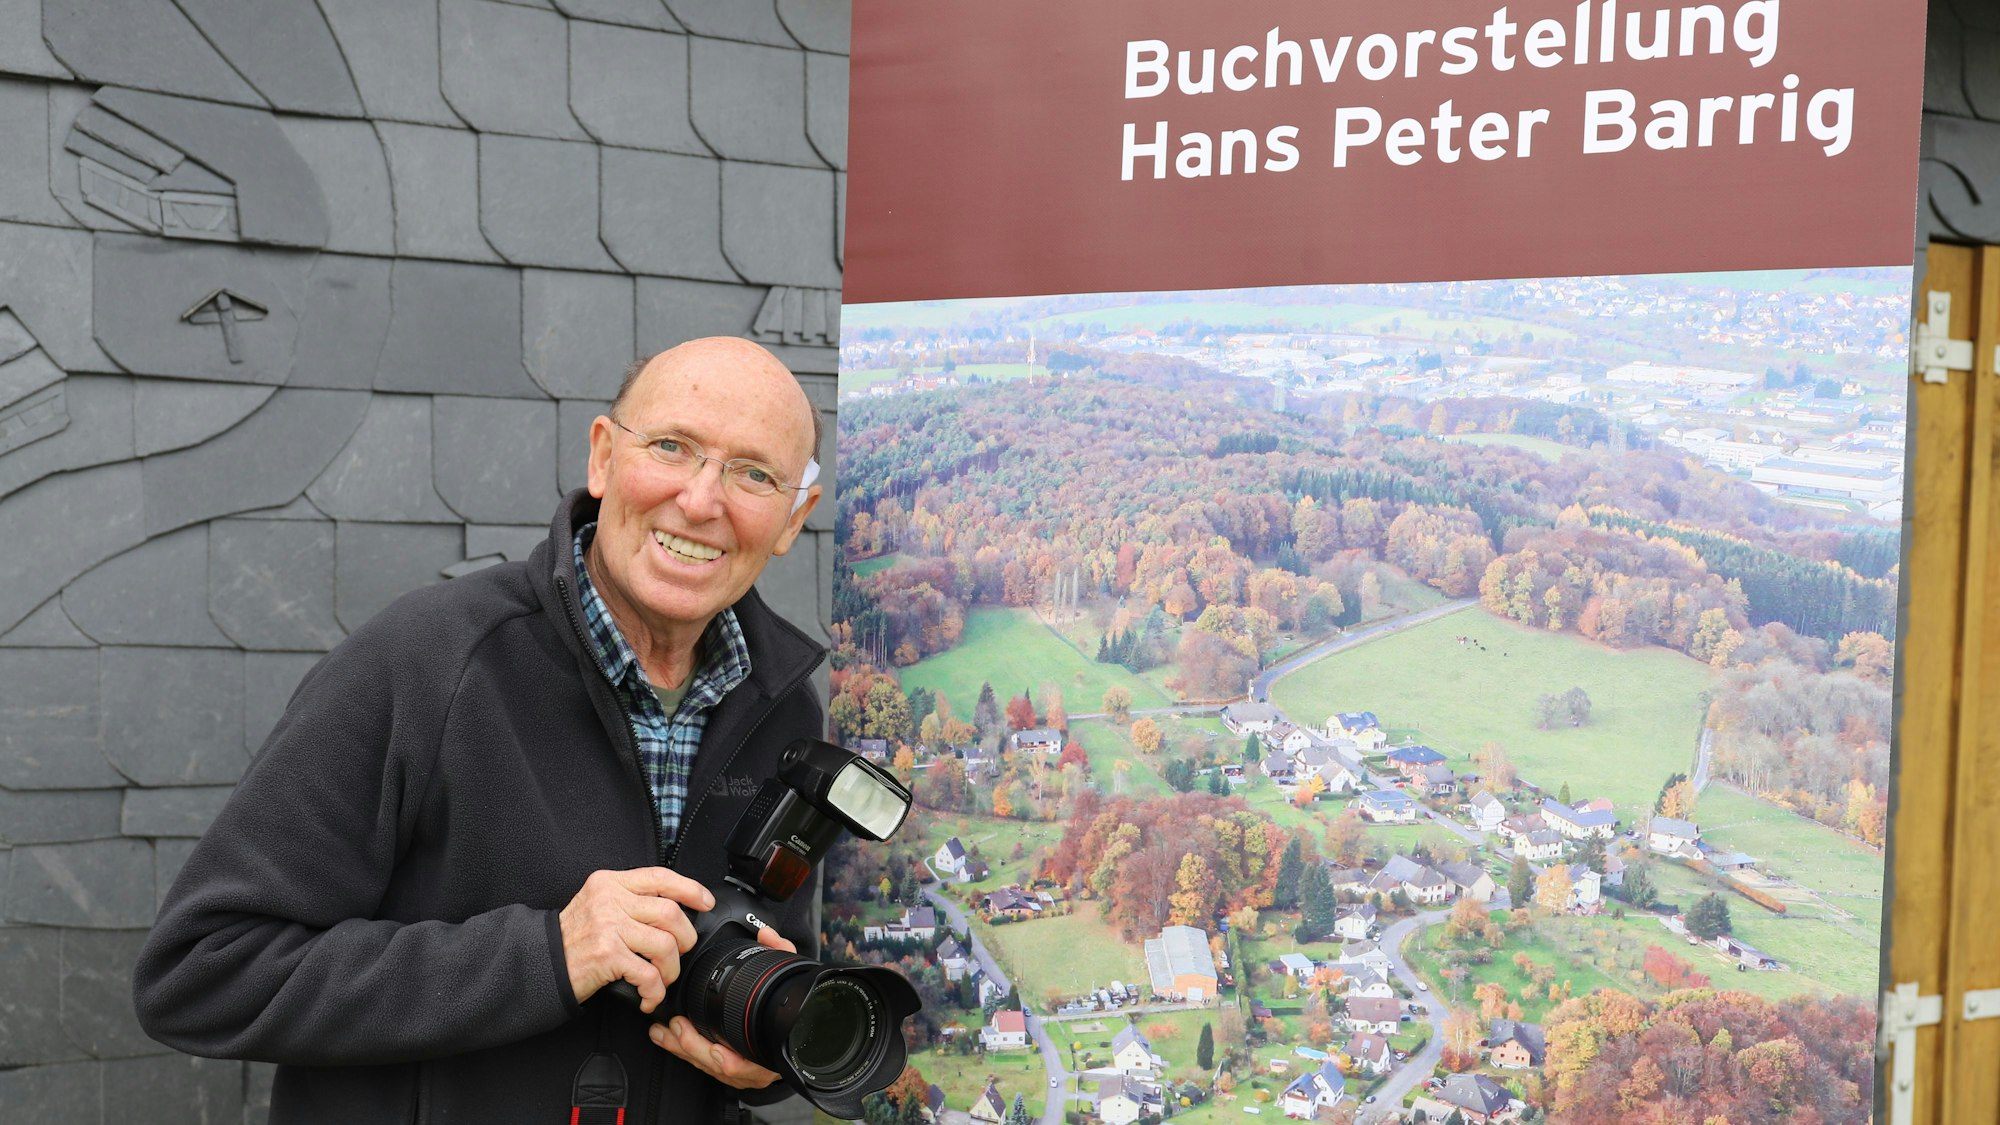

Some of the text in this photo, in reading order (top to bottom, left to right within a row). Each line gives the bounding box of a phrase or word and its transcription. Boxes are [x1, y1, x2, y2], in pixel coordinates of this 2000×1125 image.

[1124, 0, 1780, 100] Buchvorstellung
[1120, 73, 1855, 181] Hans Peter Barrig
[728, 774, 753, 786] Jack
[729, 785, 758, 797] Wolf
[790, 834, 811, 852] Canon
[745, 912, 766, 928] Can
